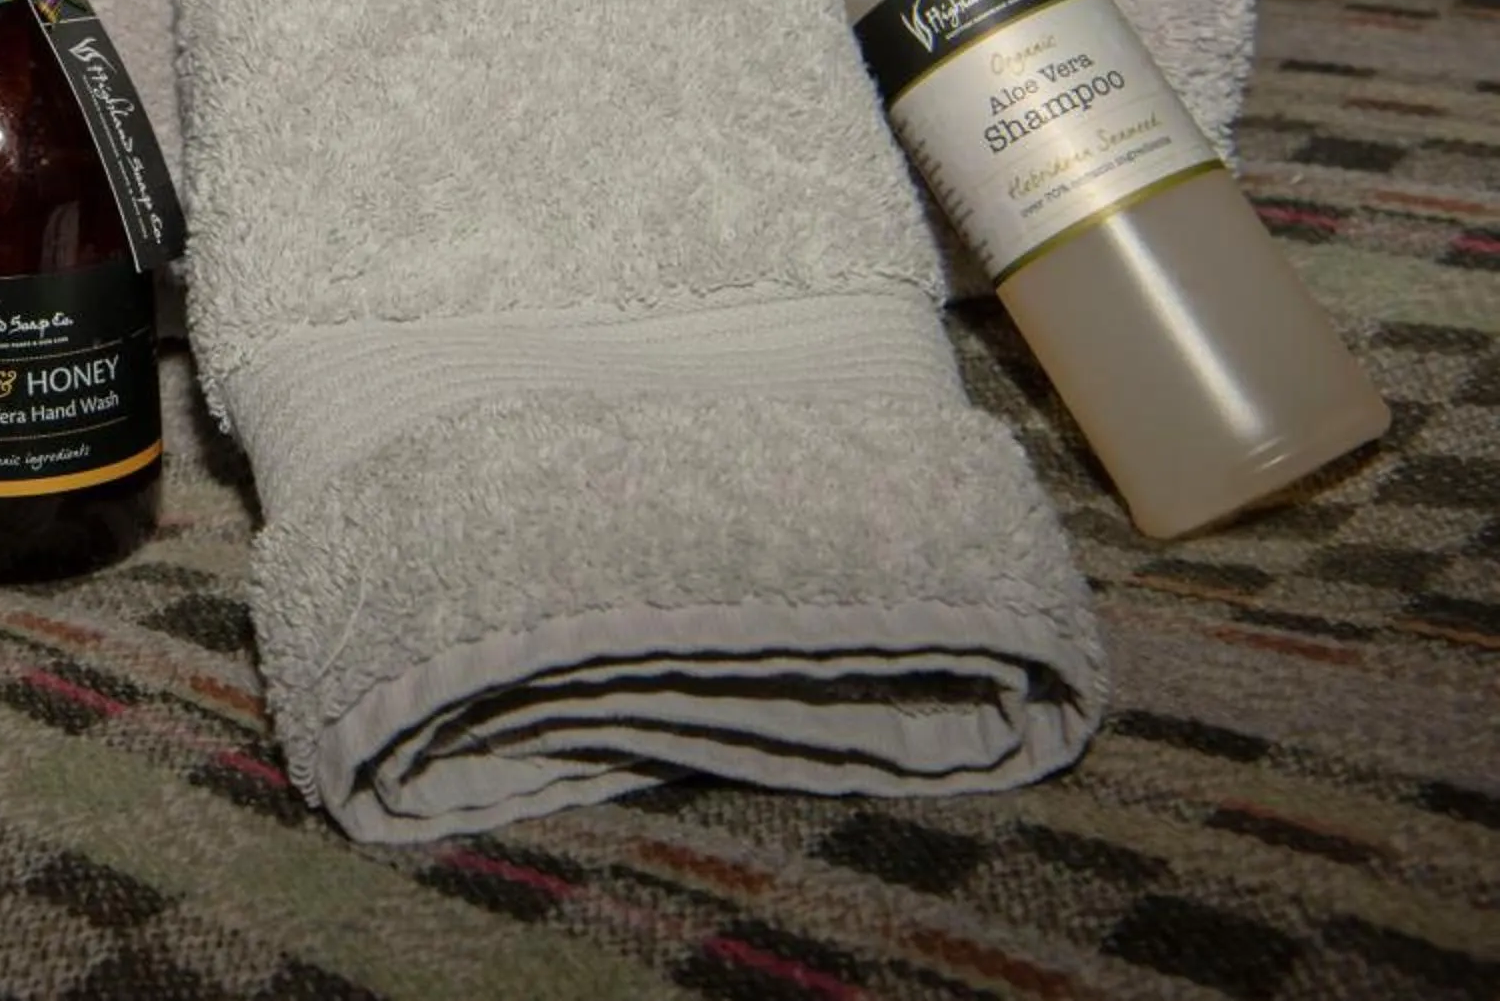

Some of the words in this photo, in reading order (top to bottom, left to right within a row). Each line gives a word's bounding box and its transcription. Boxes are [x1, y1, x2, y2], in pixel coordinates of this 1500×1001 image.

[989, 78, 1040, 117] Aloe
[1036, 53, 1095, 83] Vera
[983, 70, 1126, 154] Shampoo
[8, 314, 49, 338] Soap
[26, 354, 119, 396] HONEY
[30, 399, 77, 423] Hand
[79, 390, 120, 414] Wash
[24, 443, 92, 471] ingredients
